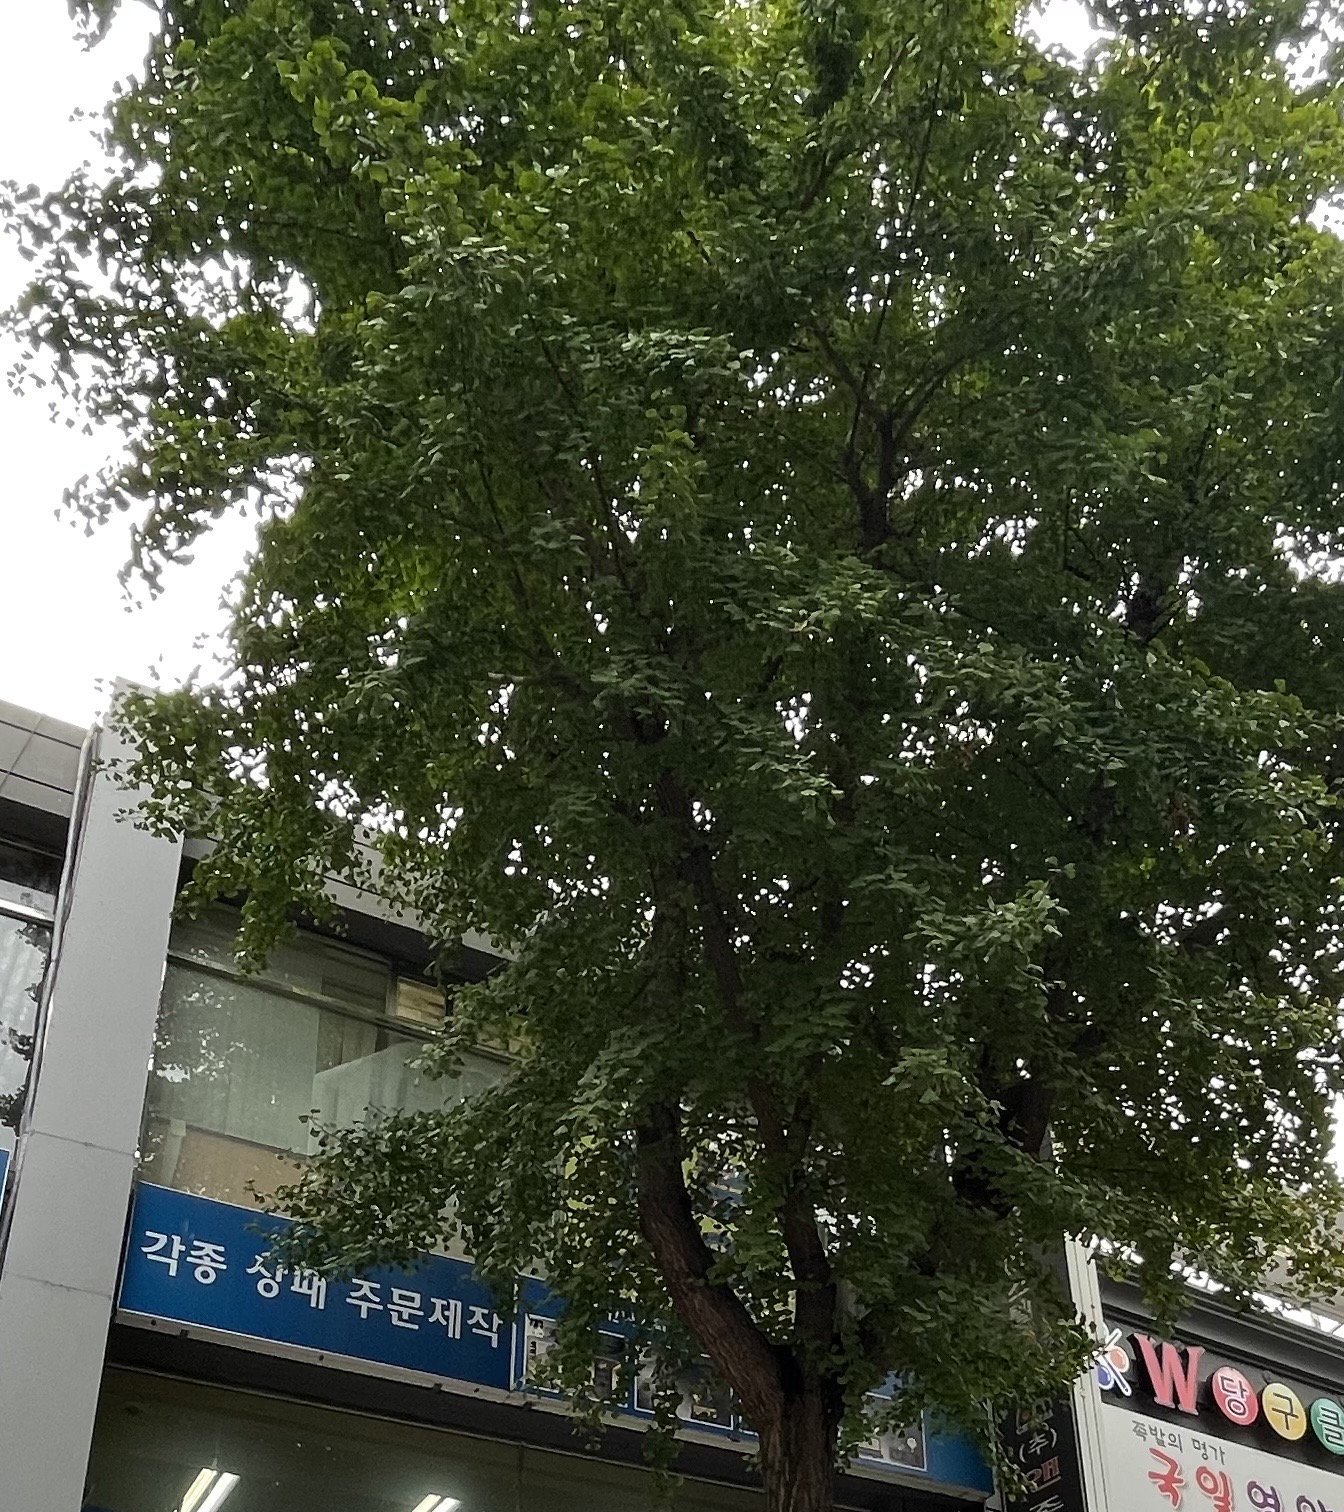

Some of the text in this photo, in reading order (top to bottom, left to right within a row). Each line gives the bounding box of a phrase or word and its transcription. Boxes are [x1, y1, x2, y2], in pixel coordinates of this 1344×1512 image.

[140, 1230, 227, 1285] 각종
[345, 1278, 504, 1348] 주문제작
[1128, 1333, 1205, 1415] W
[1131, 1419, 1226, 1464] 족발의 명가
